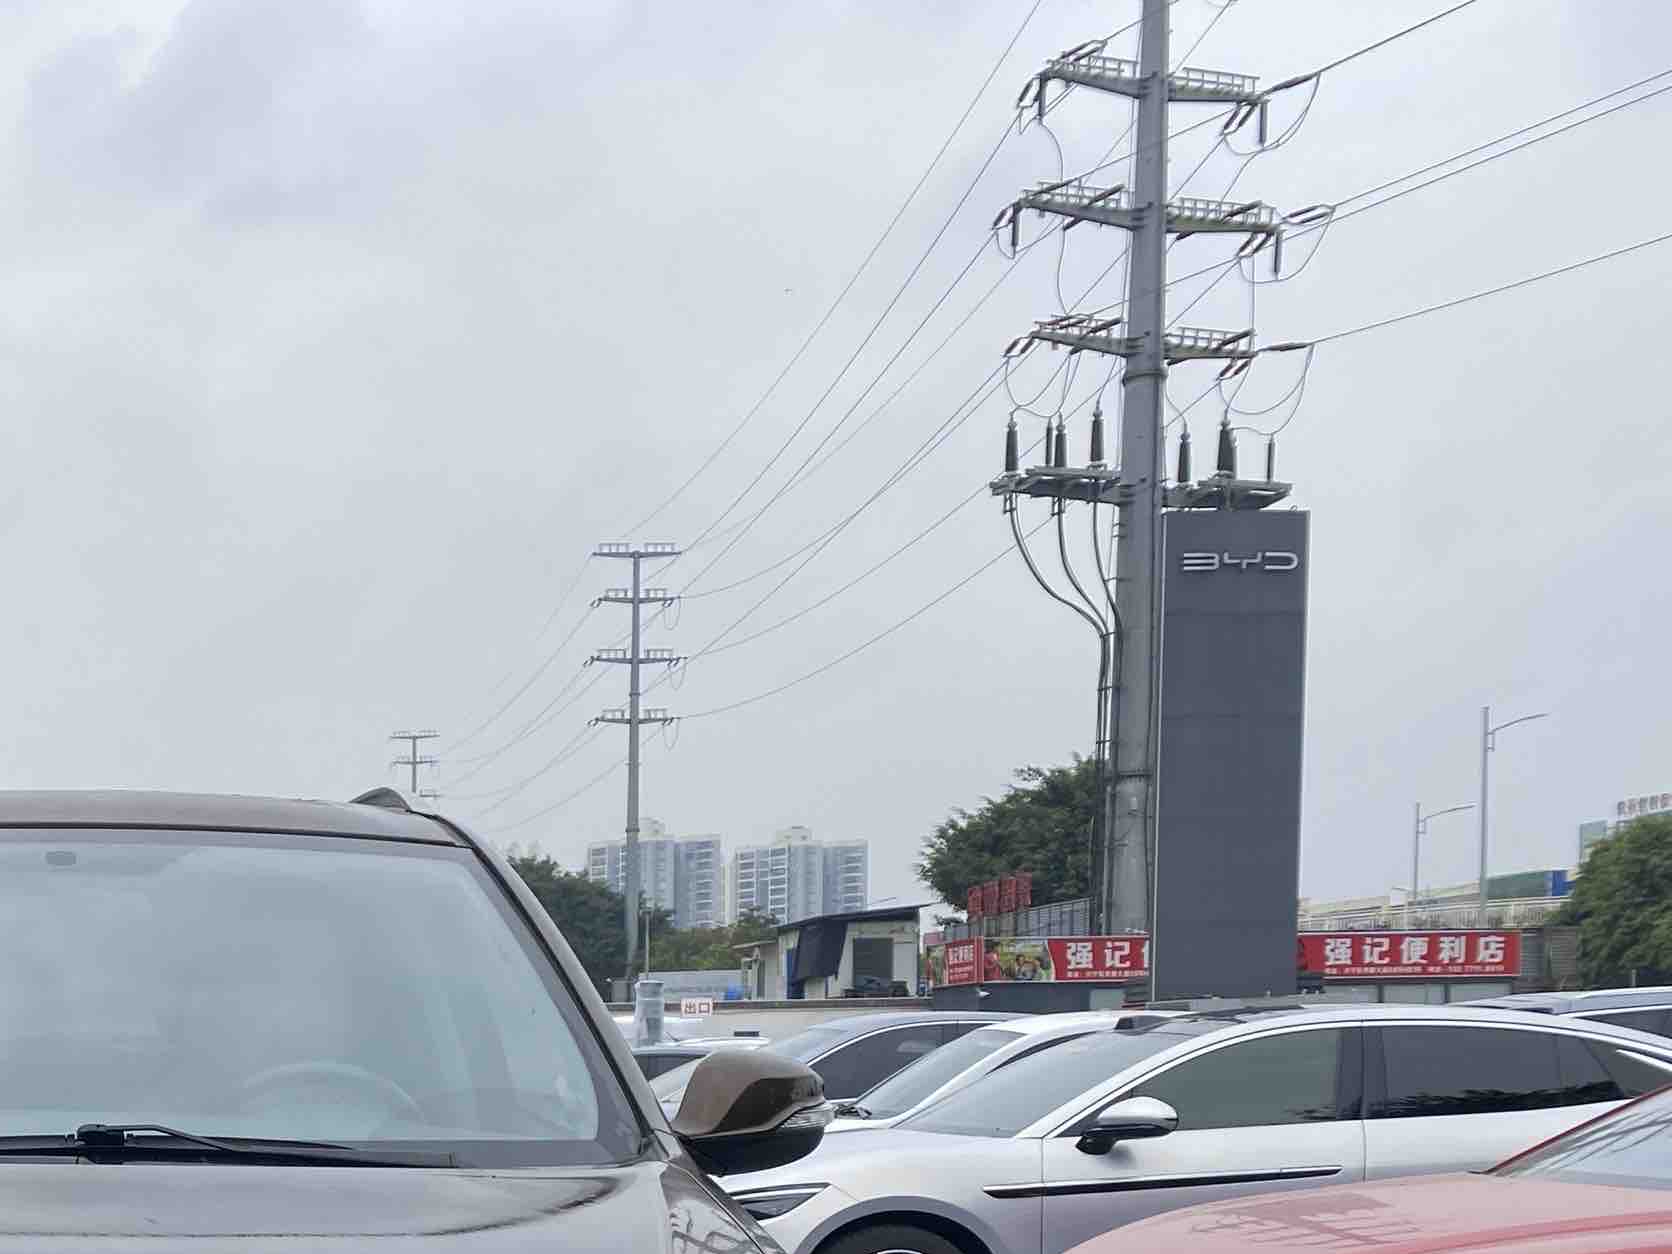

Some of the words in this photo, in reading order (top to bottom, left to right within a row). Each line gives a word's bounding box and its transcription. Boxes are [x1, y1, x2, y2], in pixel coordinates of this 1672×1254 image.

[1183, 551, 1299, 571] BYD
[1324, 935, 1505, 966] 强记便利店
